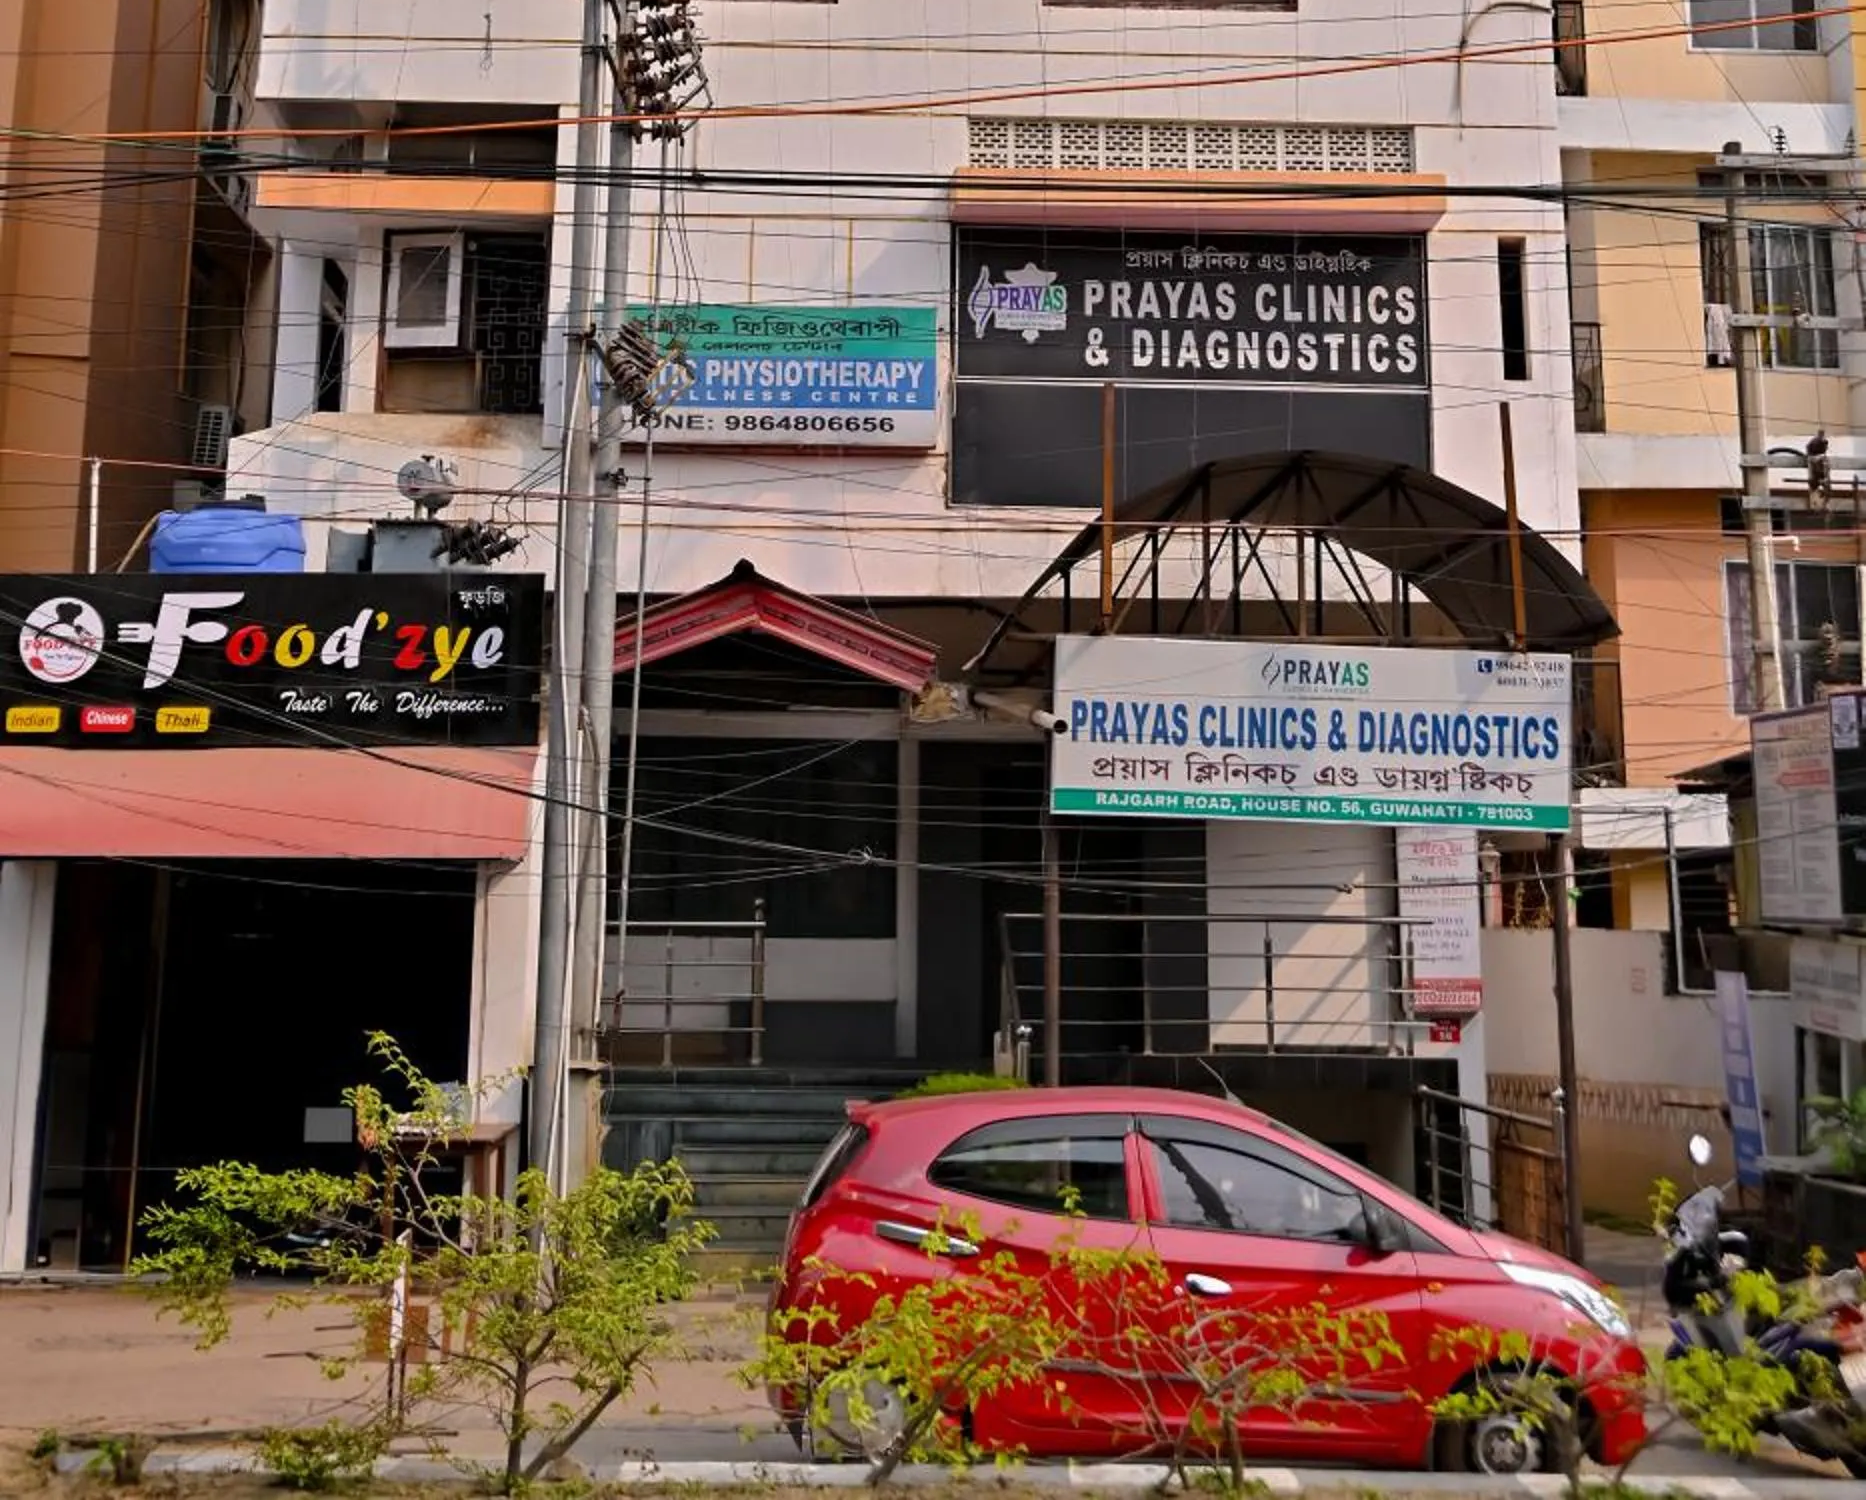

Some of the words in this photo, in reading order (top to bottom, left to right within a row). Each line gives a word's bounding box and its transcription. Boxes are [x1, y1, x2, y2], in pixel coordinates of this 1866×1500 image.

[997, 286, 1065, 312] PRAYAS
[1084, 280, 1236, 321] PRAYAS
[1255, 284, 1417, 325] CLINICS
[1085, 328, 1109, 367] &
[1132, 329, 1417, 373] DIAGNOSTICS
[706, 359, 925, 389] PHYSIOTHERAPY
[658, 390, 792, 403] ELLNESS
[811, 390, 918, 403] CENTRE
[620, 414, 714, 431] HONE:
[725, 416, 895, 432] 9864806656
[118, 591, 504, 688] Food'zye
[1283, 659, 1370, 687] PRAYAS
[86, 709, 129, 725] Chinese
[280, 691, 327, 713] Taste
[346, 691, 379, 713] The
[396, 691, 504, 719] Difference...
[11, 712, 55, 728] Indian
[1071, 700, 1188, 747] PRAYAS
[1200, 705, 1317, 752] CLINICS
[1328, 709, 1347, 752] &
[1359, 711, 1559, 759] DIAGNOSTICS
[1096, 791, 1178, 807] RAJGARH
[1184, 795, 1236, 812] ROAD,
[1241, 797, 1300, 813] HOUSE
[1306, 800, 1336, 813] NO.
[1341, 801, 1365, 816] 56,
[1370, 802, 1463, 818] GUWAHATI
[1478, 806, 1533, 821] 781003
